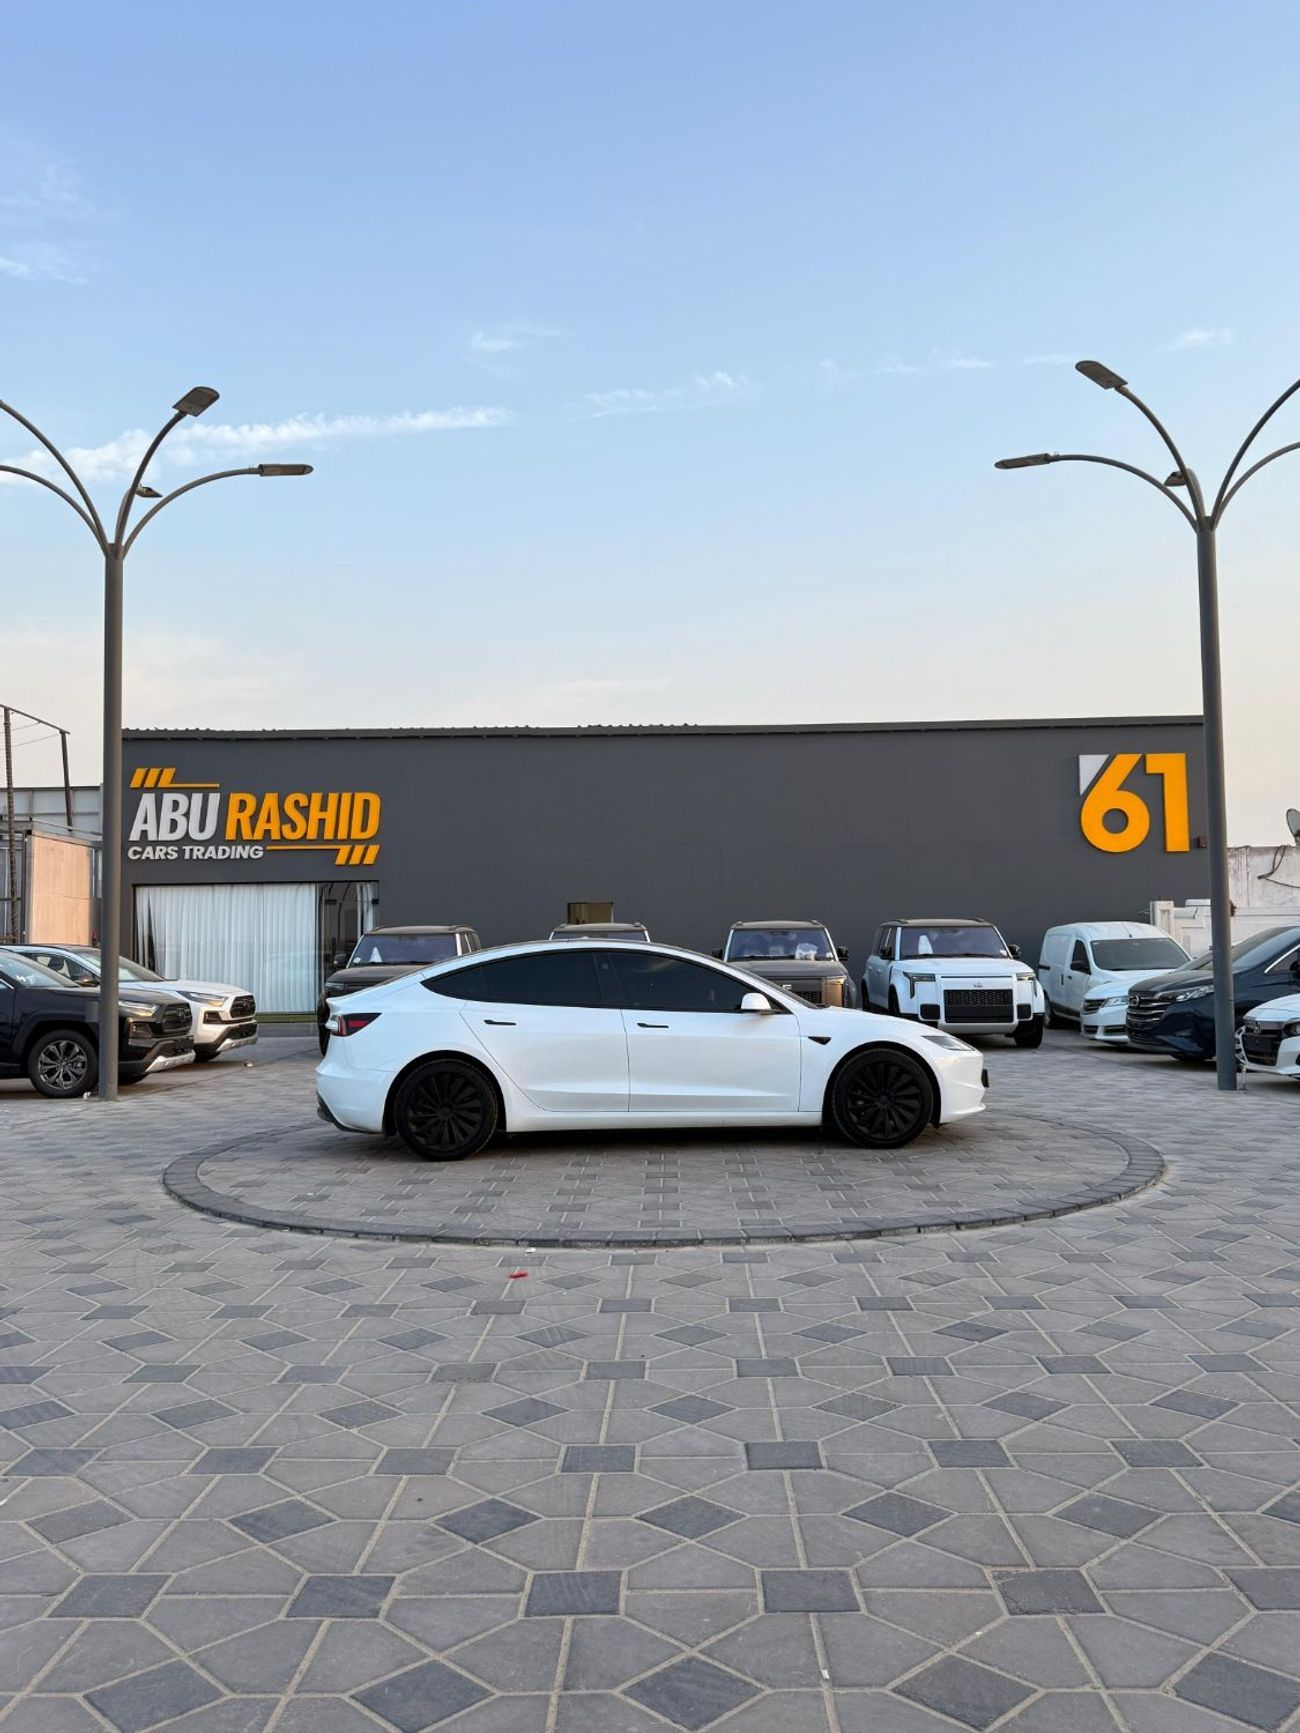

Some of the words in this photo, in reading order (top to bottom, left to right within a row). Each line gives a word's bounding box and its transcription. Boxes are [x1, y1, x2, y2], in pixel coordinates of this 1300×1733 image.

[129, 792, 220, 842] ABU
[225, 792, 381, 841] RASHID
[1080, 753, 1190, 853] 61
[127, 845, 179, 860] CARS
[182, 845, 264, 860] TRADING
